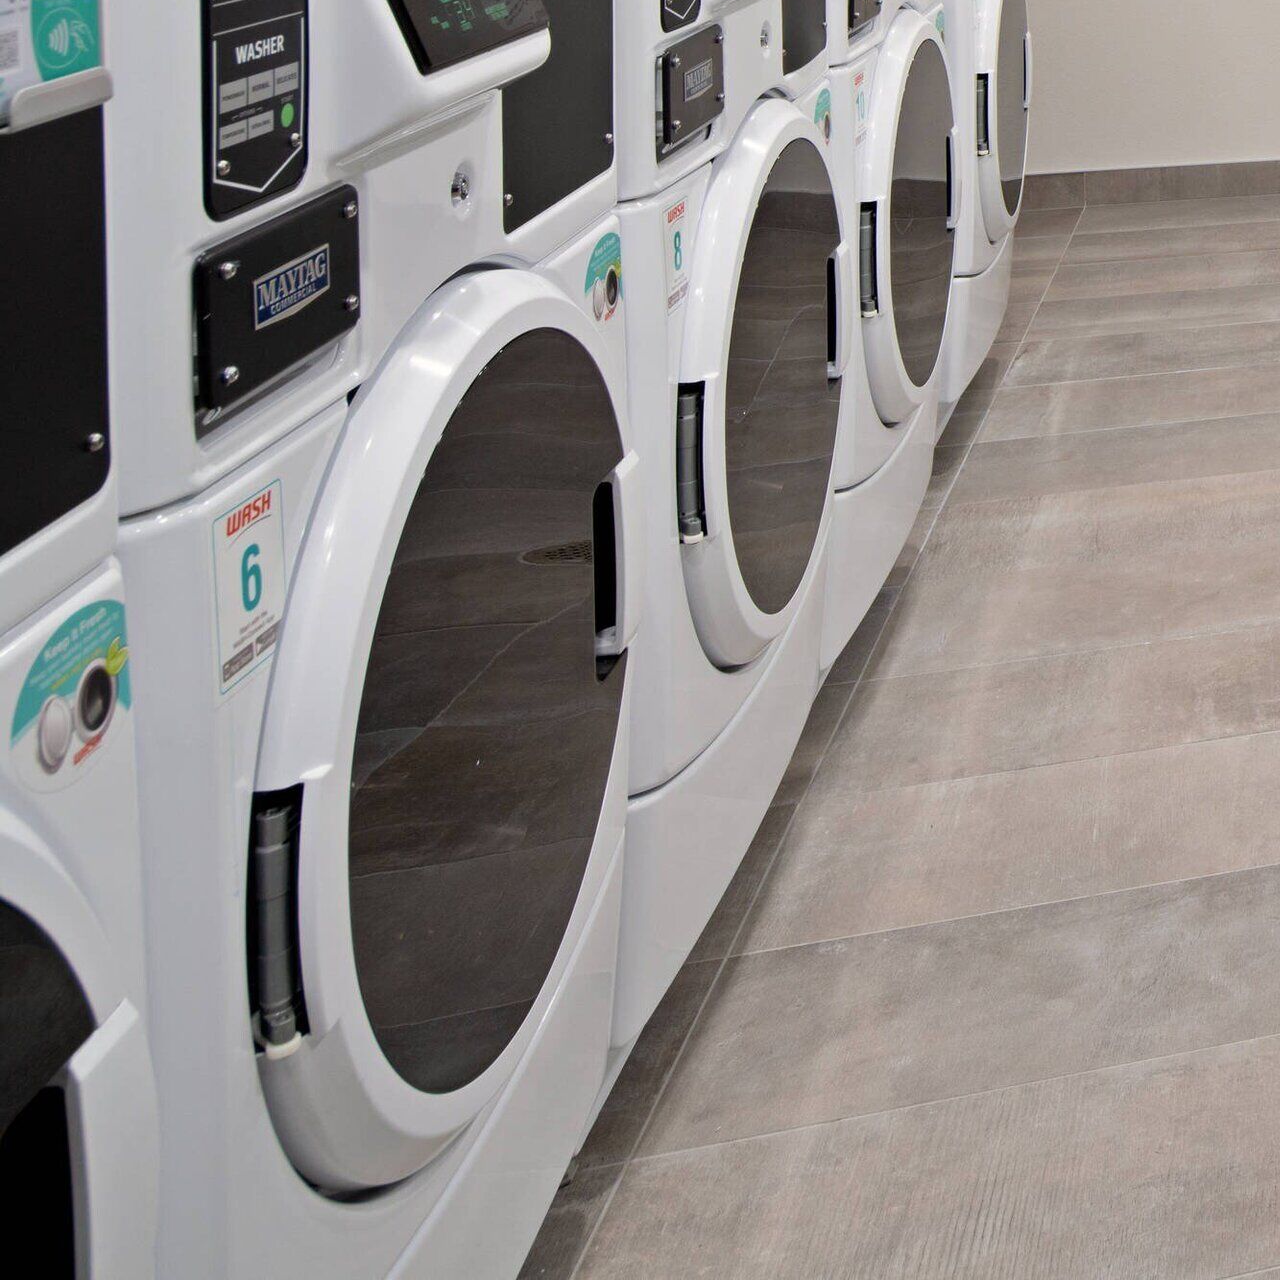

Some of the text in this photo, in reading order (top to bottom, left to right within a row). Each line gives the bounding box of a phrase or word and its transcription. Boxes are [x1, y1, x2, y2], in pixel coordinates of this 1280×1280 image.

[235, 35, 284, 64] WASHER
[668, 201, 685, 223] WASH
[674, 231, 682, 271] 8
[258, 252, 326, 311] MAYTAG
[270, 285, 317, 315] COMMERCIAL
[226, 490, 271, 537] WASH
[241, 543, 262, 612] 6
